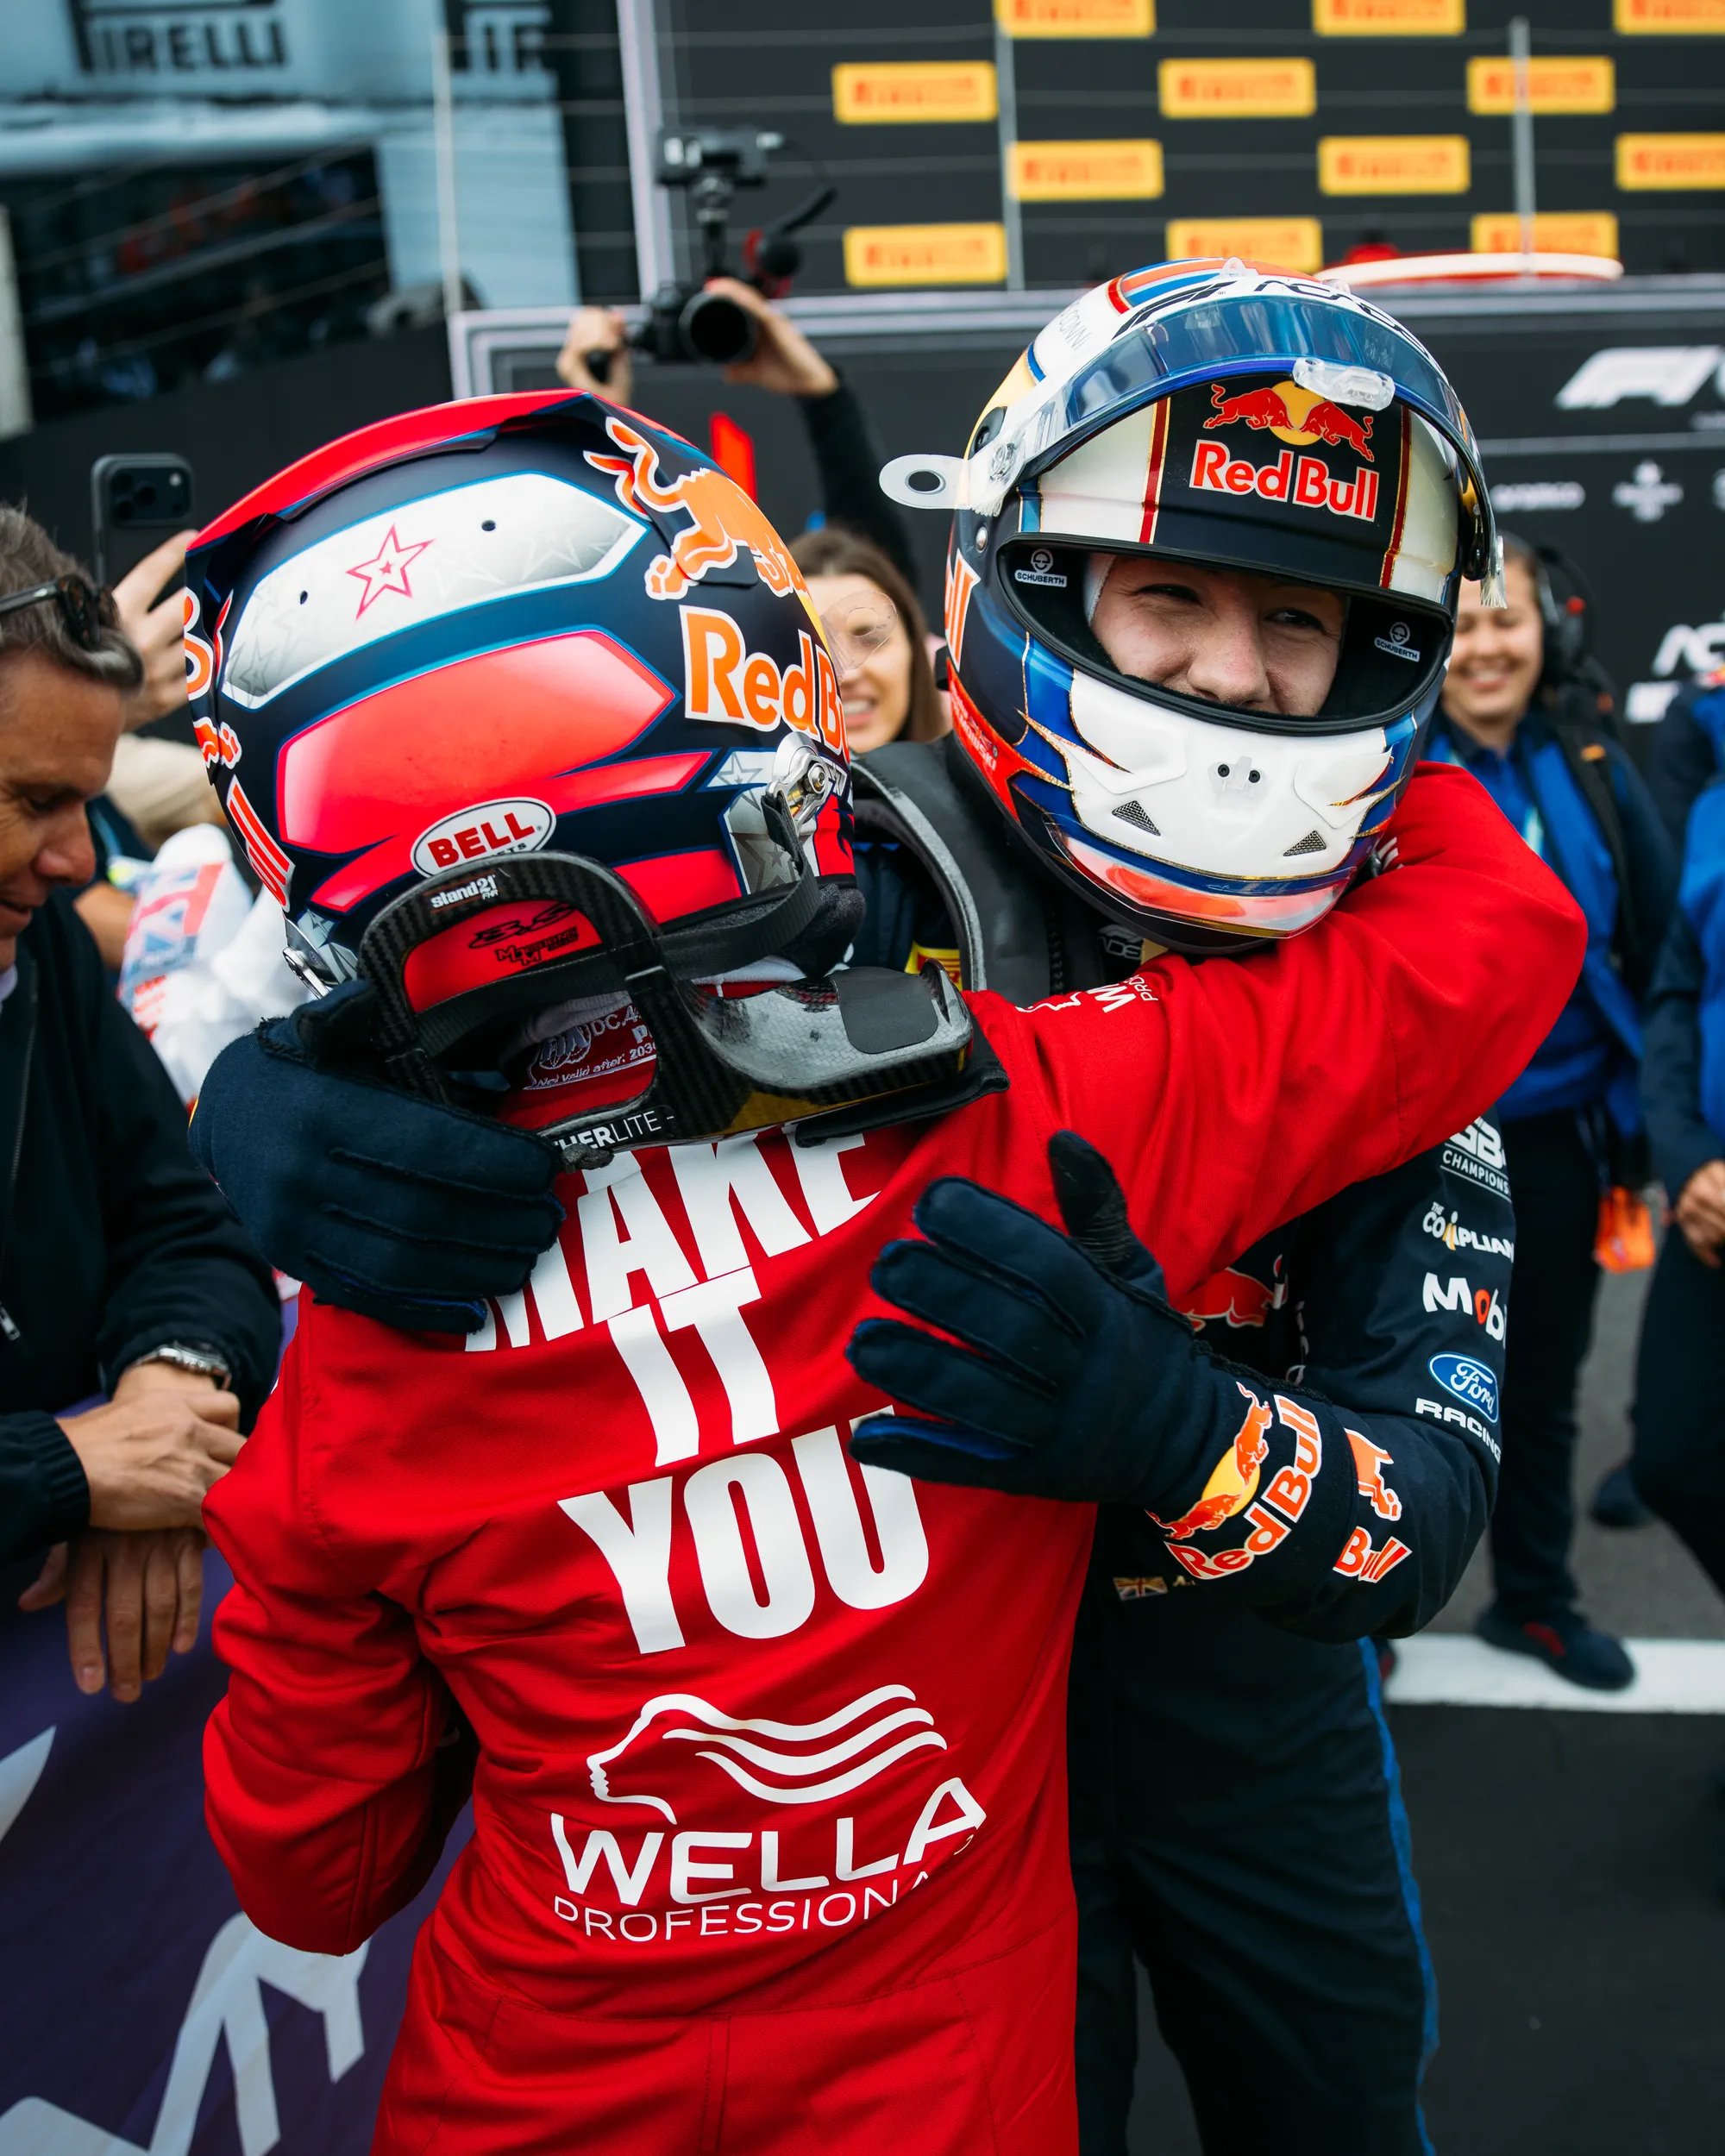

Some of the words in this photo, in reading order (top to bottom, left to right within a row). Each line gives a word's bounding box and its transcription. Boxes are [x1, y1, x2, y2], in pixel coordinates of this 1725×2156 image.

[1189, 439, 1294, 502] Red
[1293, 455, 1380, 522] Bull
[1016, 572, 1065, 586] SCHUBERTH
[679, 604, 821, 743] Red
[1376, 639, 1418, 660] SCHUBERTH
[427, 812, 535, 868] BELL
[561, 1066, 590, 1082] valid
[593, 1054, 626, 1073] after:
[630, 1043, 656, 1060] 203
[553, 1111, 662, 1151] HERLITE
[1449, 1116, 1507, 1169] GB
[1443, 1150, 1509, 1194] CHAMPIONS
[1431, 1201, 1445, 1215] THE
[1423, 1272, 1508, 1350] Mob
[607, 1265, 780, 1468] IT
[1450, 1363, 1496, 1414] Ford
[1415, 1397, 1502, 1464] RACING
[1164, 1501, 1292, 1580] Red
[1260, 1395, 1322, 1523] Bull
[557, 1405, 930, 1654] YOU
[550, 1777, 987, 1907] WELLA
